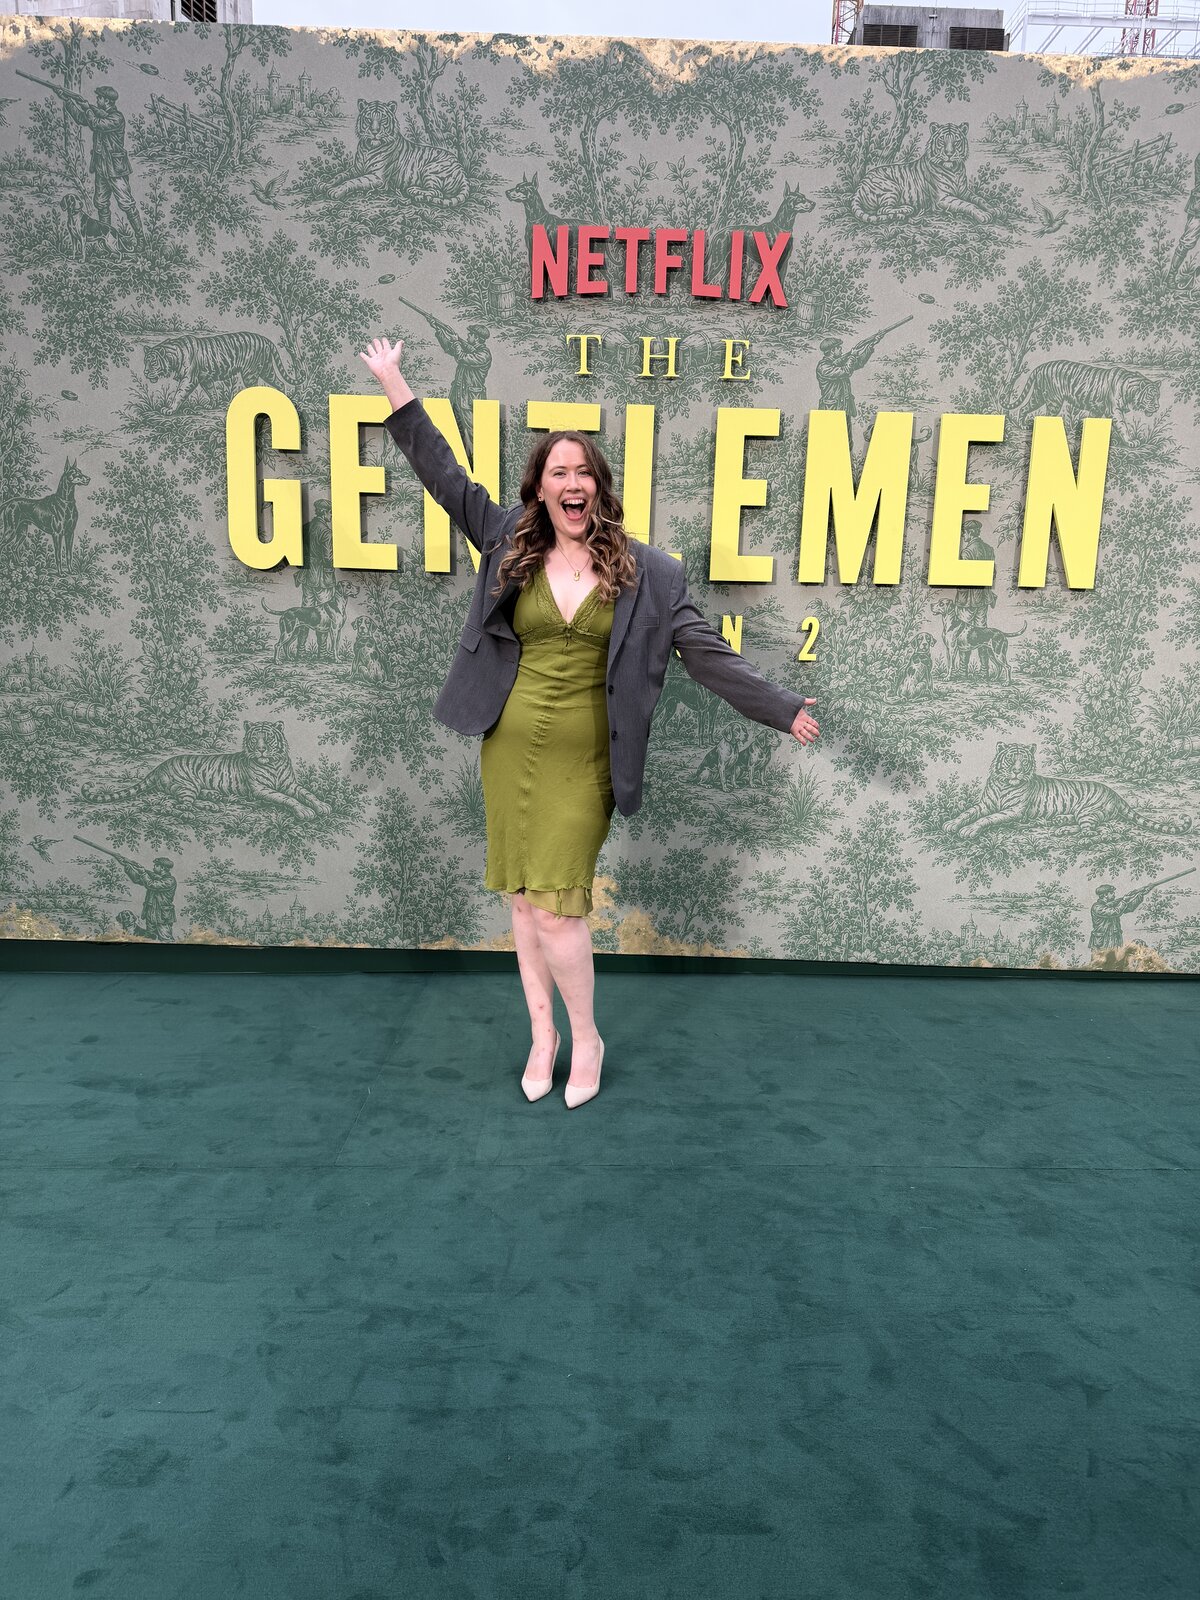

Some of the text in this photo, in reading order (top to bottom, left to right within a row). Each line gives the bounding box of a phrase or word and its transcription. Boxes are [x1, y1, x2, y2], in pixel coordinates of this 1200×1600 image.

[531, 224, 792, 307] NETFLIX
[566, 334, 751, 380] THE
[798, 616, 820, 661] 2
